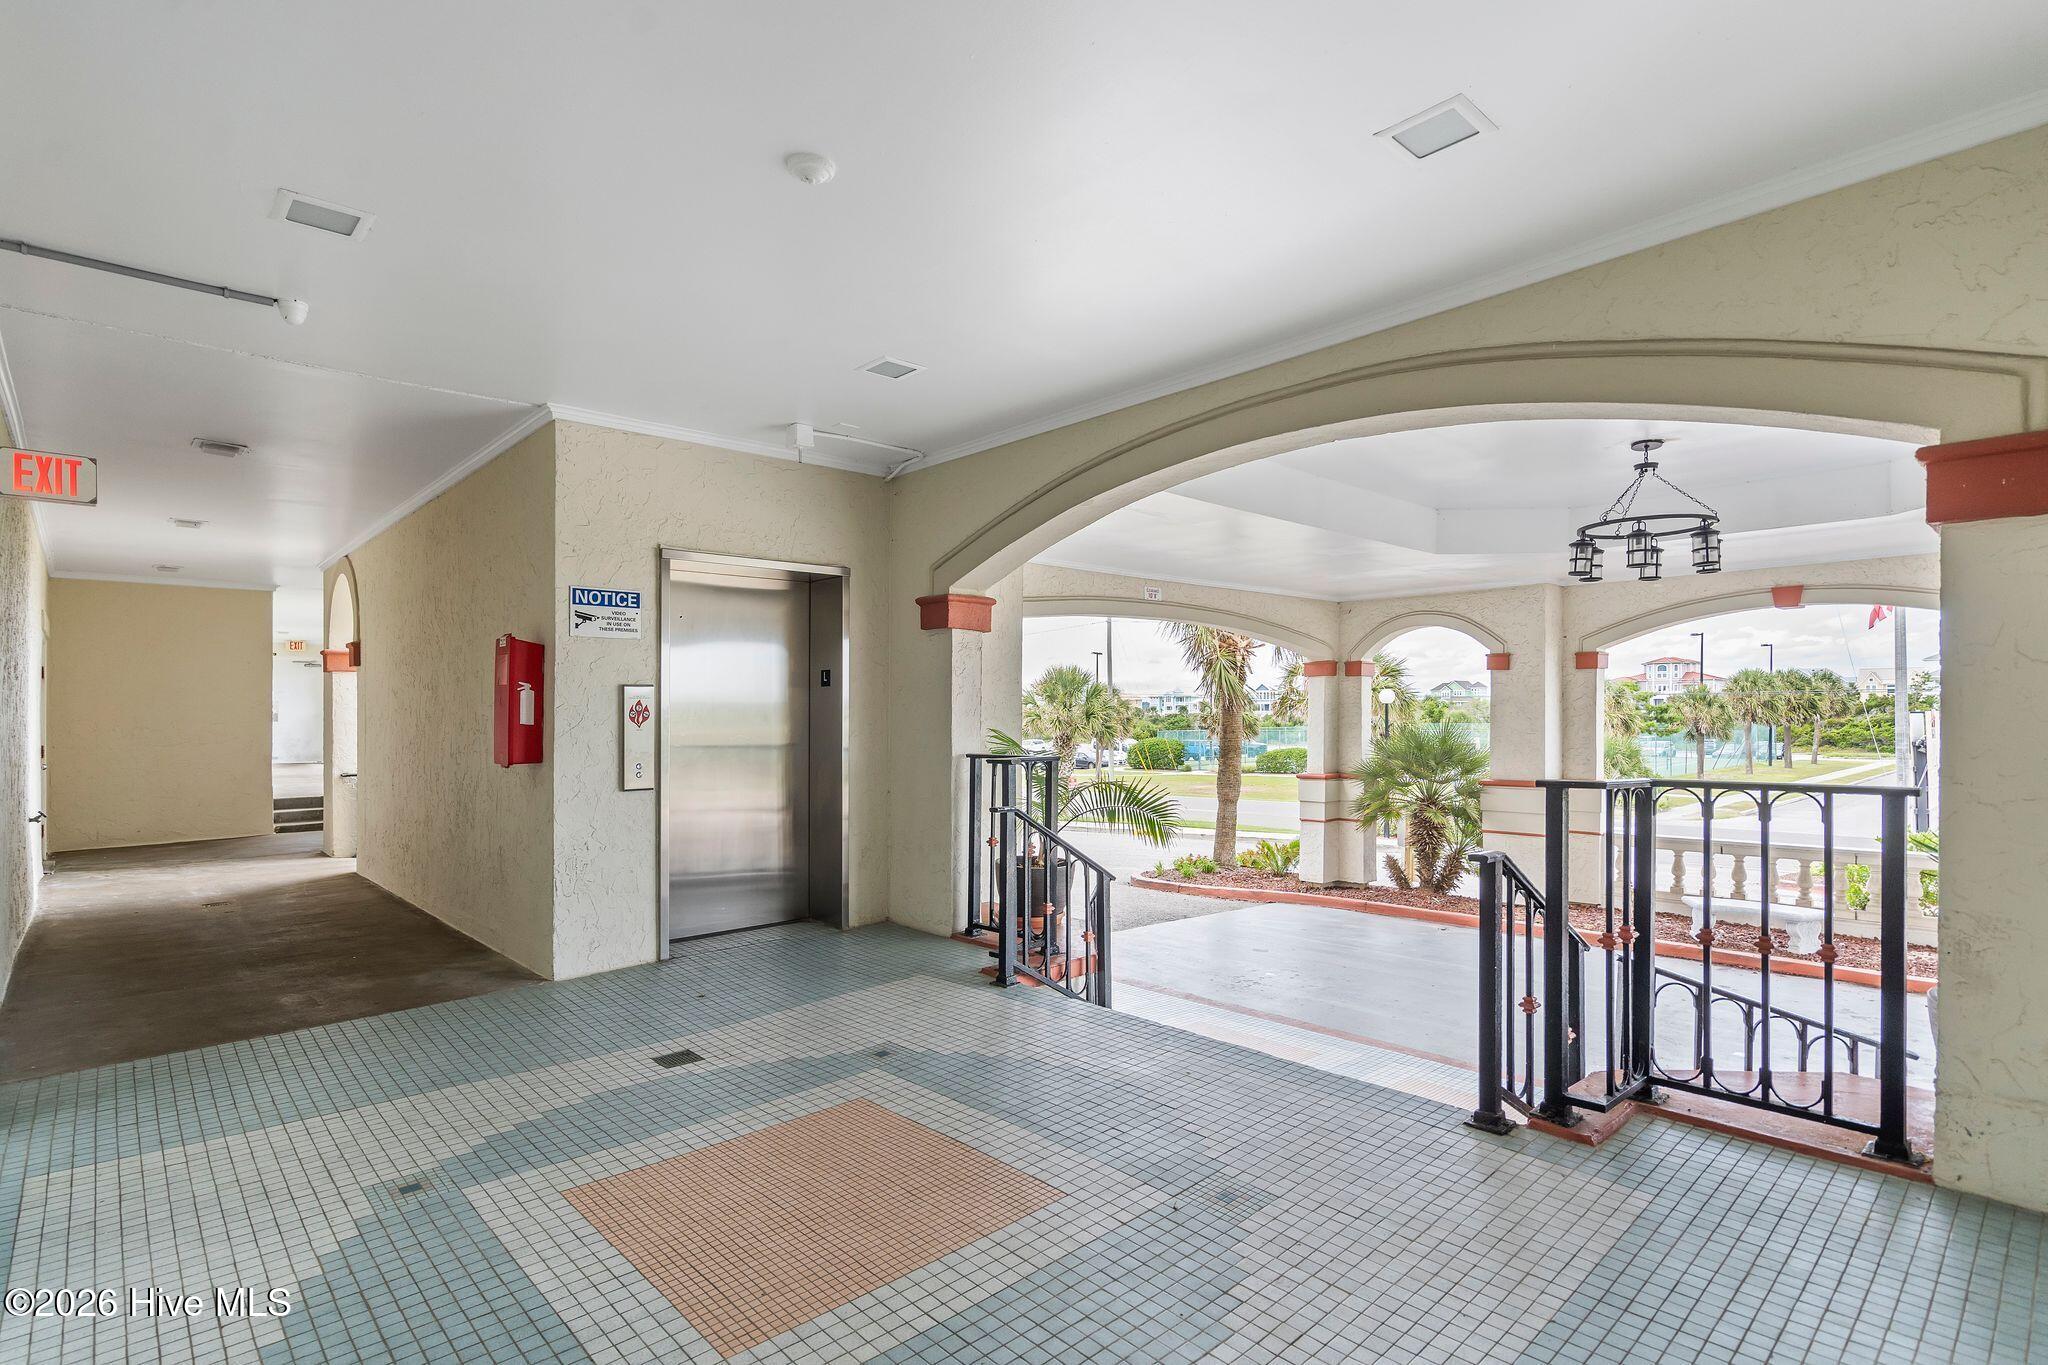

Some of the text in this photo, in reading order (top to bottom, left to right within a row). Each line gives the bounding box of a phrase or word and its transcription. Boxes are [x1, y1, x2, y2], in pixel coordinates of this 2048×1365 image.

[13, 453, 82, 496] EXIT
[575, 590, 637, 606] NOTICE
[290, 641, 304, 650] EXIT
